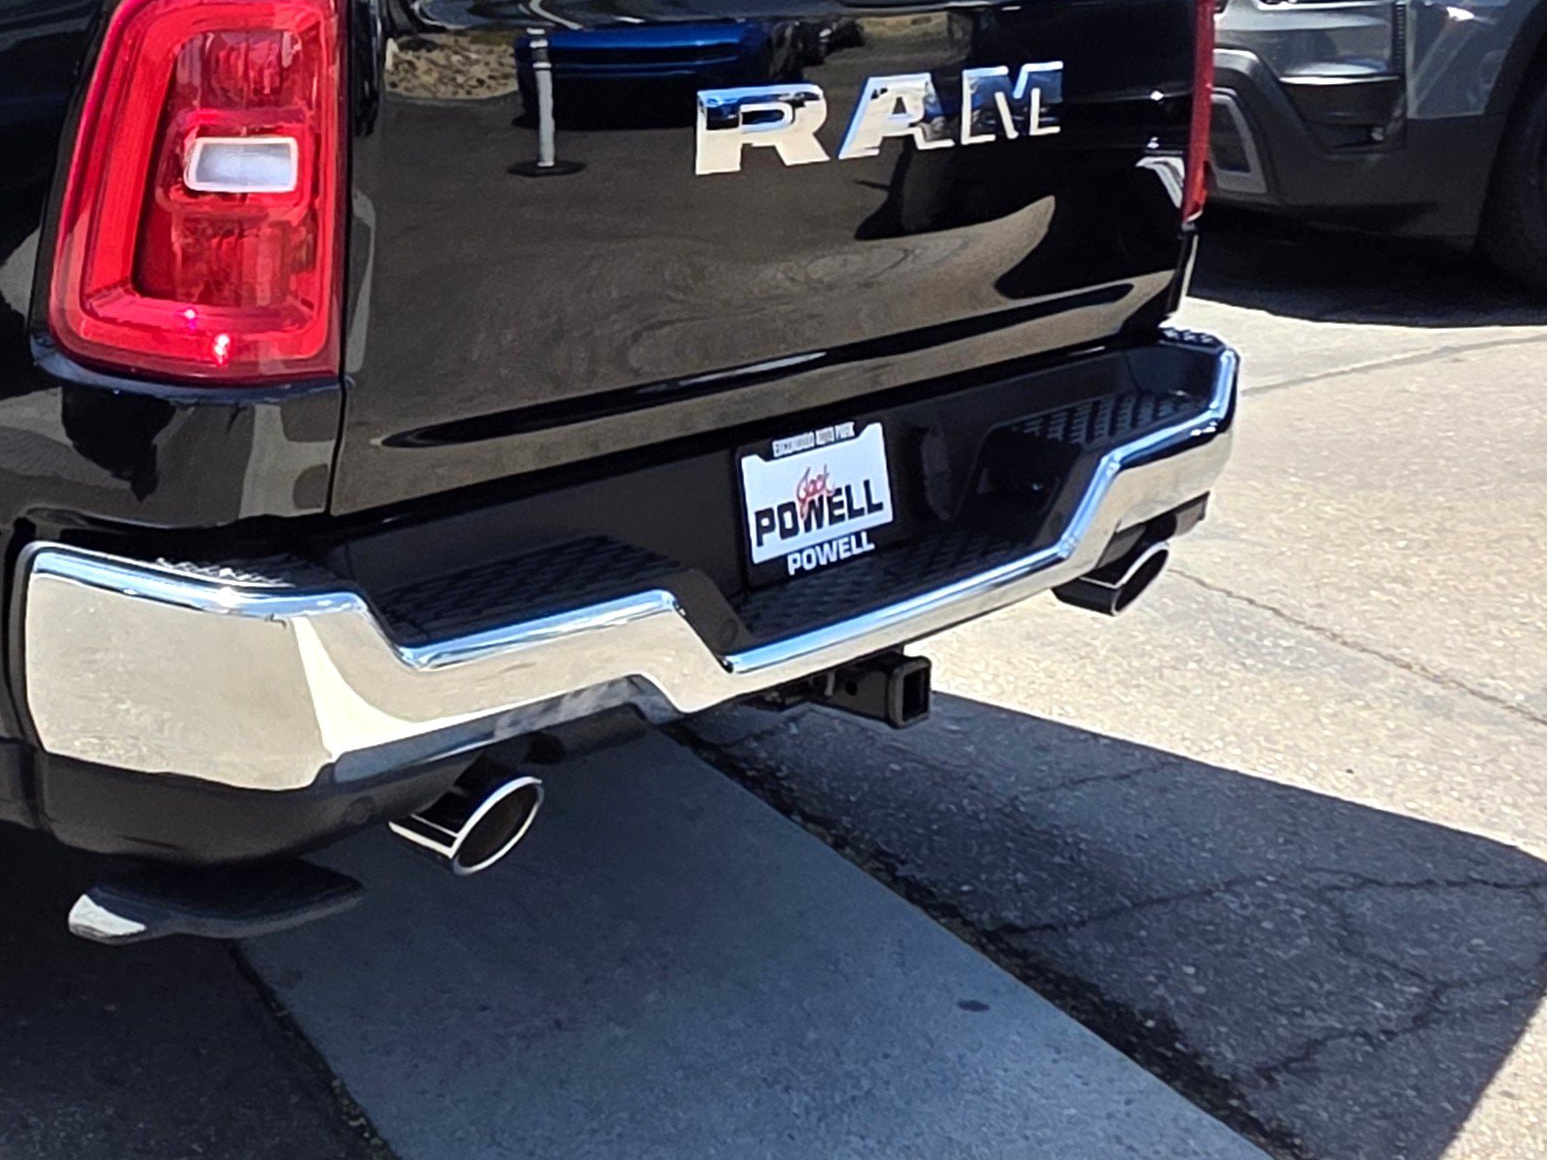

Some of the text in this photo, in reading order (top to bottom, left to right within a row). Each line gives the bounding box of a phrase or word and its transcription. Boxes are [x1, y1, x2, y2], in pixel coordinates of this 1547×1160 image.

[695, 60, 1064, 176] RAM
[754, 479, 884, 547] POWELL
[786, 531, 876, 576] POWELL
